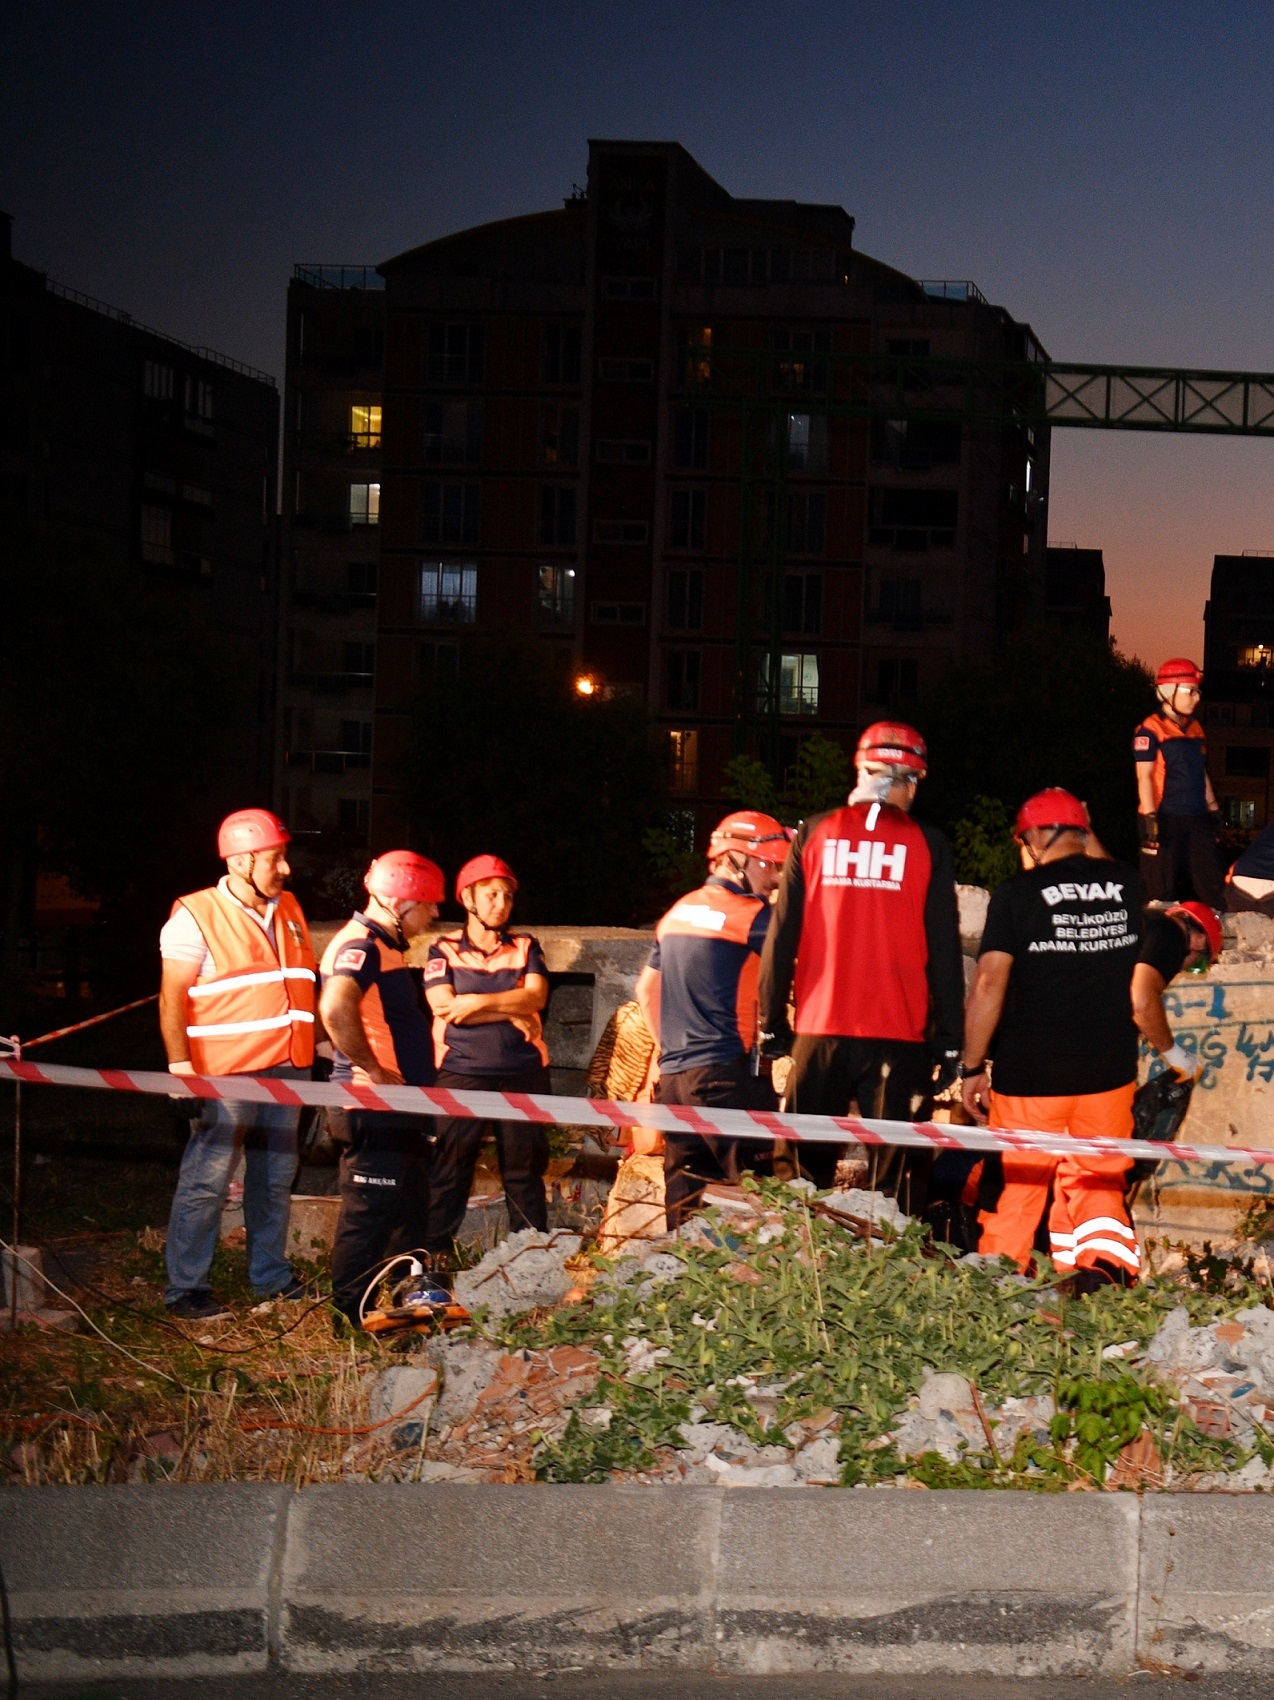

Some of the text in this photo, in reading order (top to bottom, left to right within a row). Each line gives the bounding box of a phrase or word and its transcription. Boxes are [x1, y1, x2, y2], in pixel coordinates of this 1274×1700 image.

[1041, 881, 1125, 907] BEYAK
[1052, 909, 1128, 926] BEYLİKDÜZÜ
[1055, 922, 1128, 939] BELEDİYESİ
[1028, 940, 1077, 952] ARAMA
